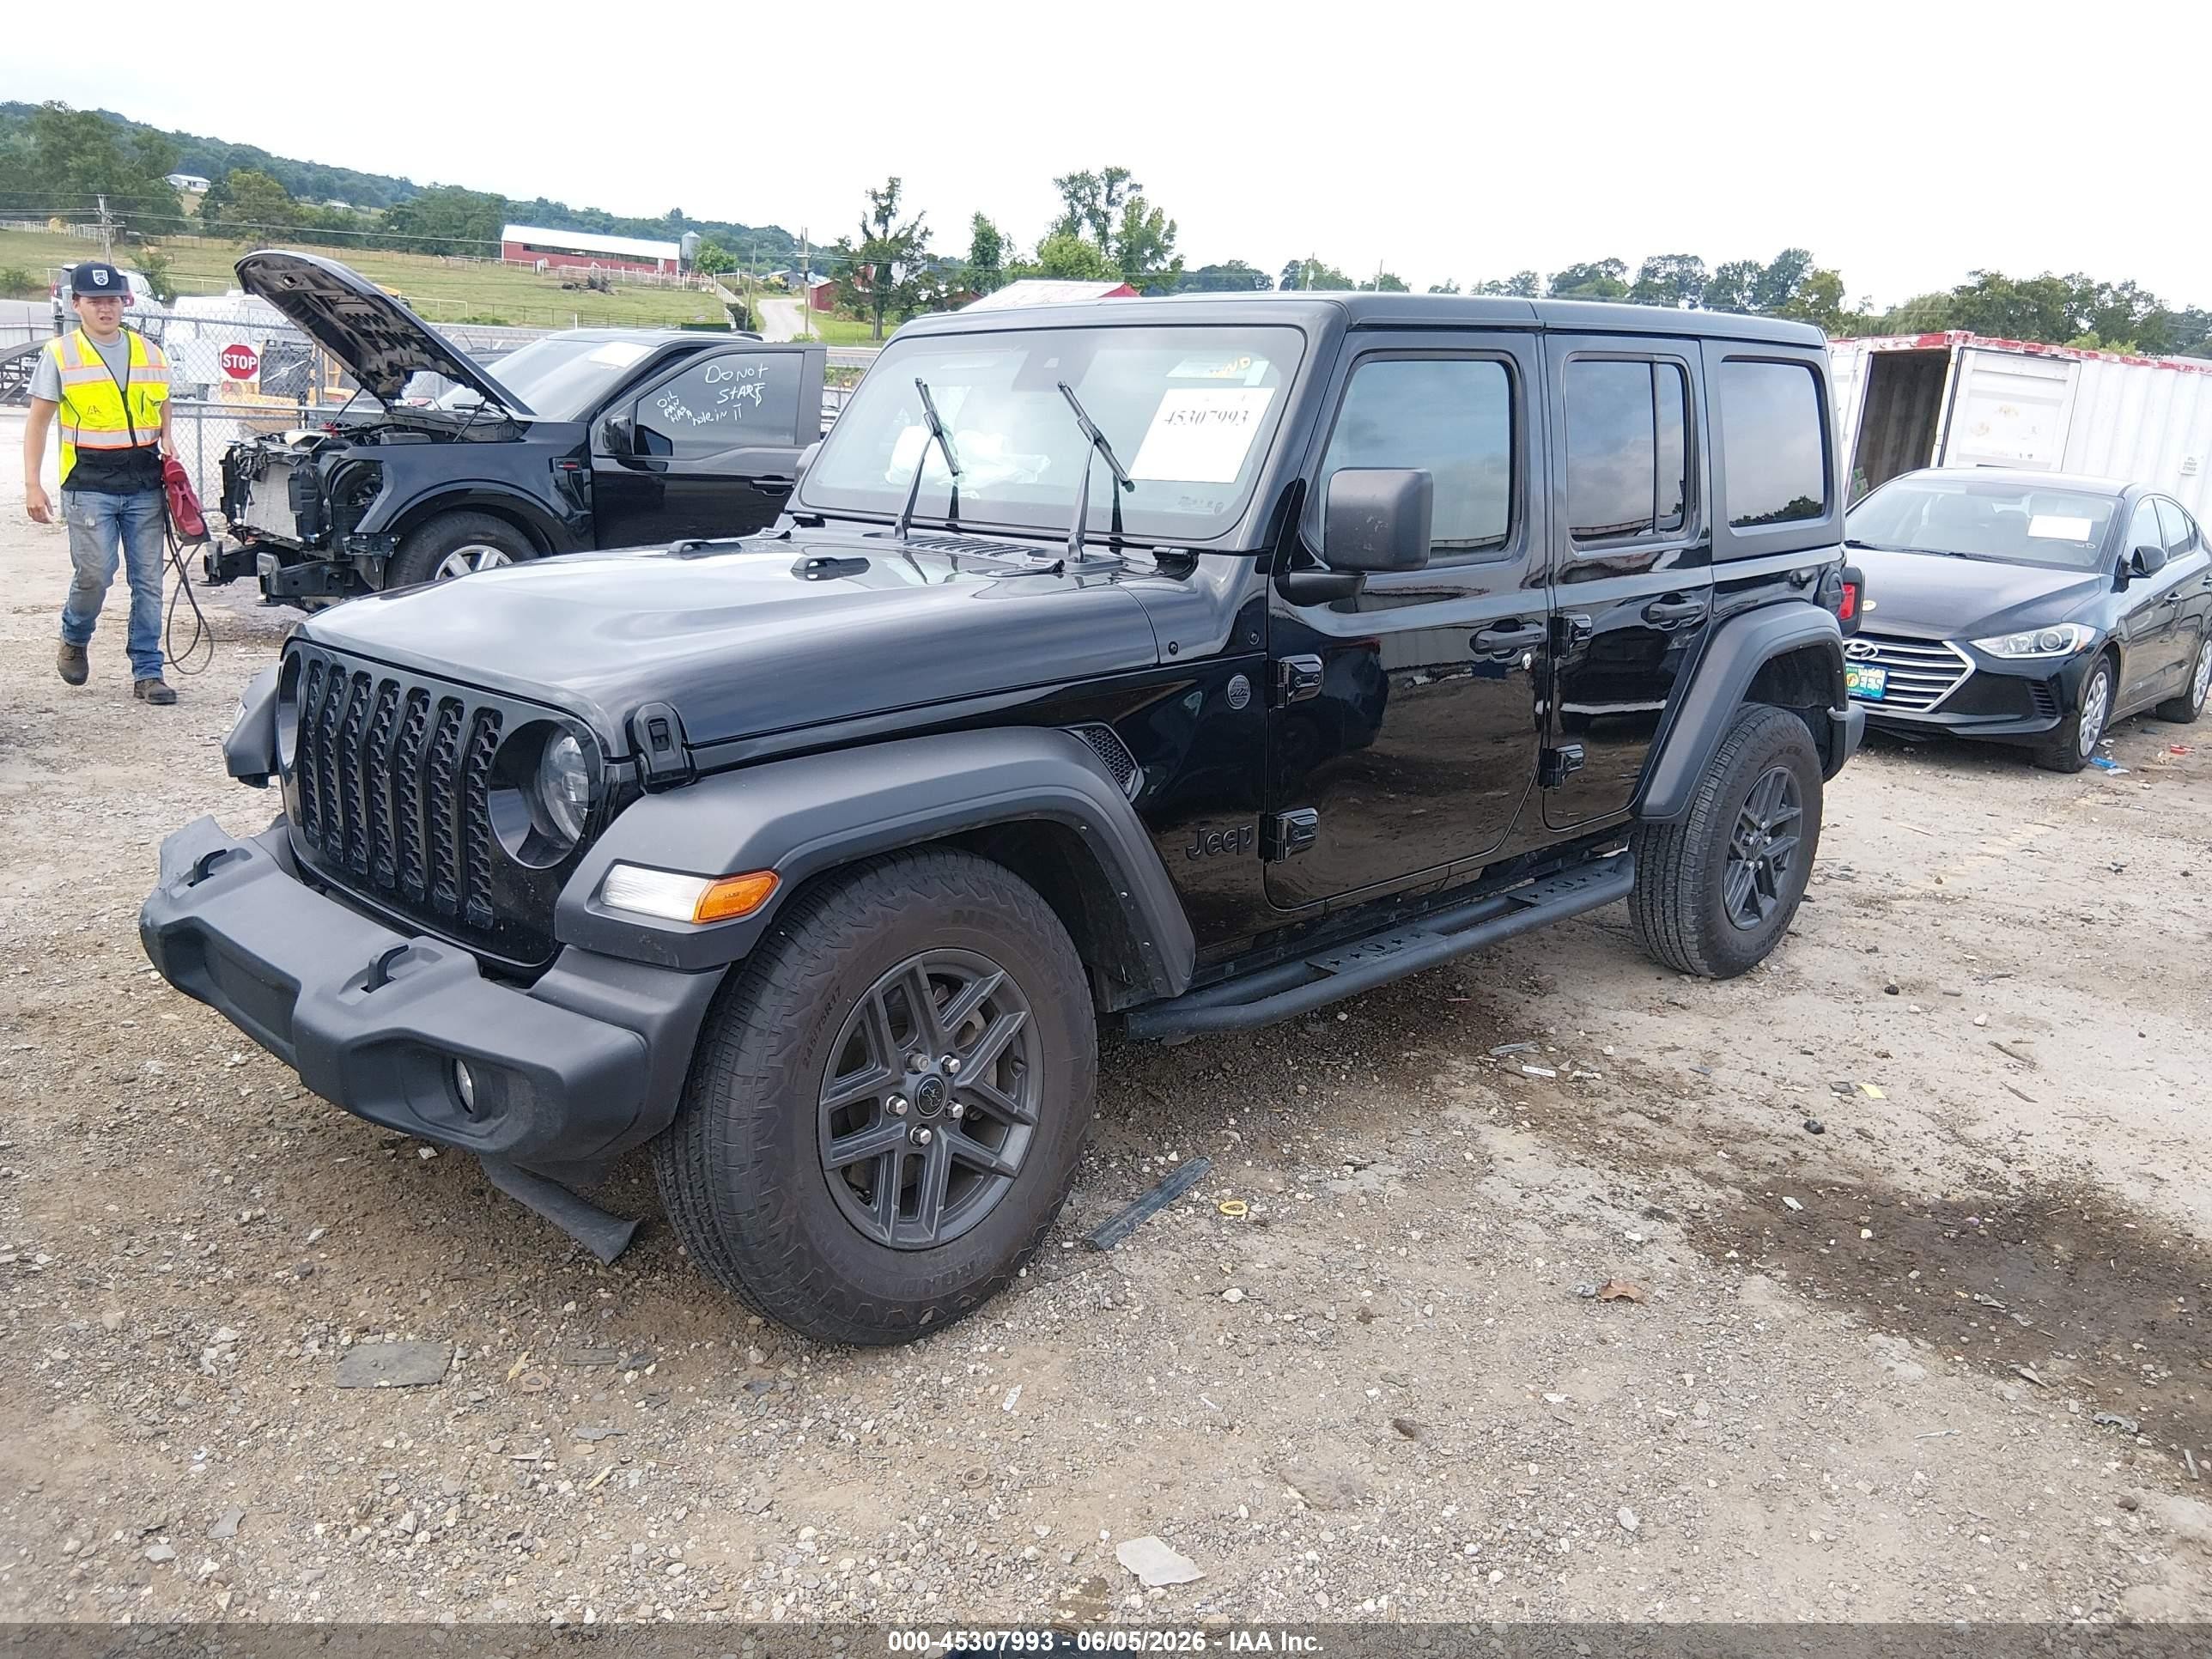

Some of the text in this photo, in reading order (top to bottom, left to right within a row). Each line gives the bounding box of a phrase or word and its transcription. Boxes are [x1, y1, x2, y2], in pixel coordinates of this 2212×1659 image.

[222, 353, 258, 370] STOP
[1164, 410, 1250, 426] 45307993
[1185, 825, 1253, 861] Jeep
